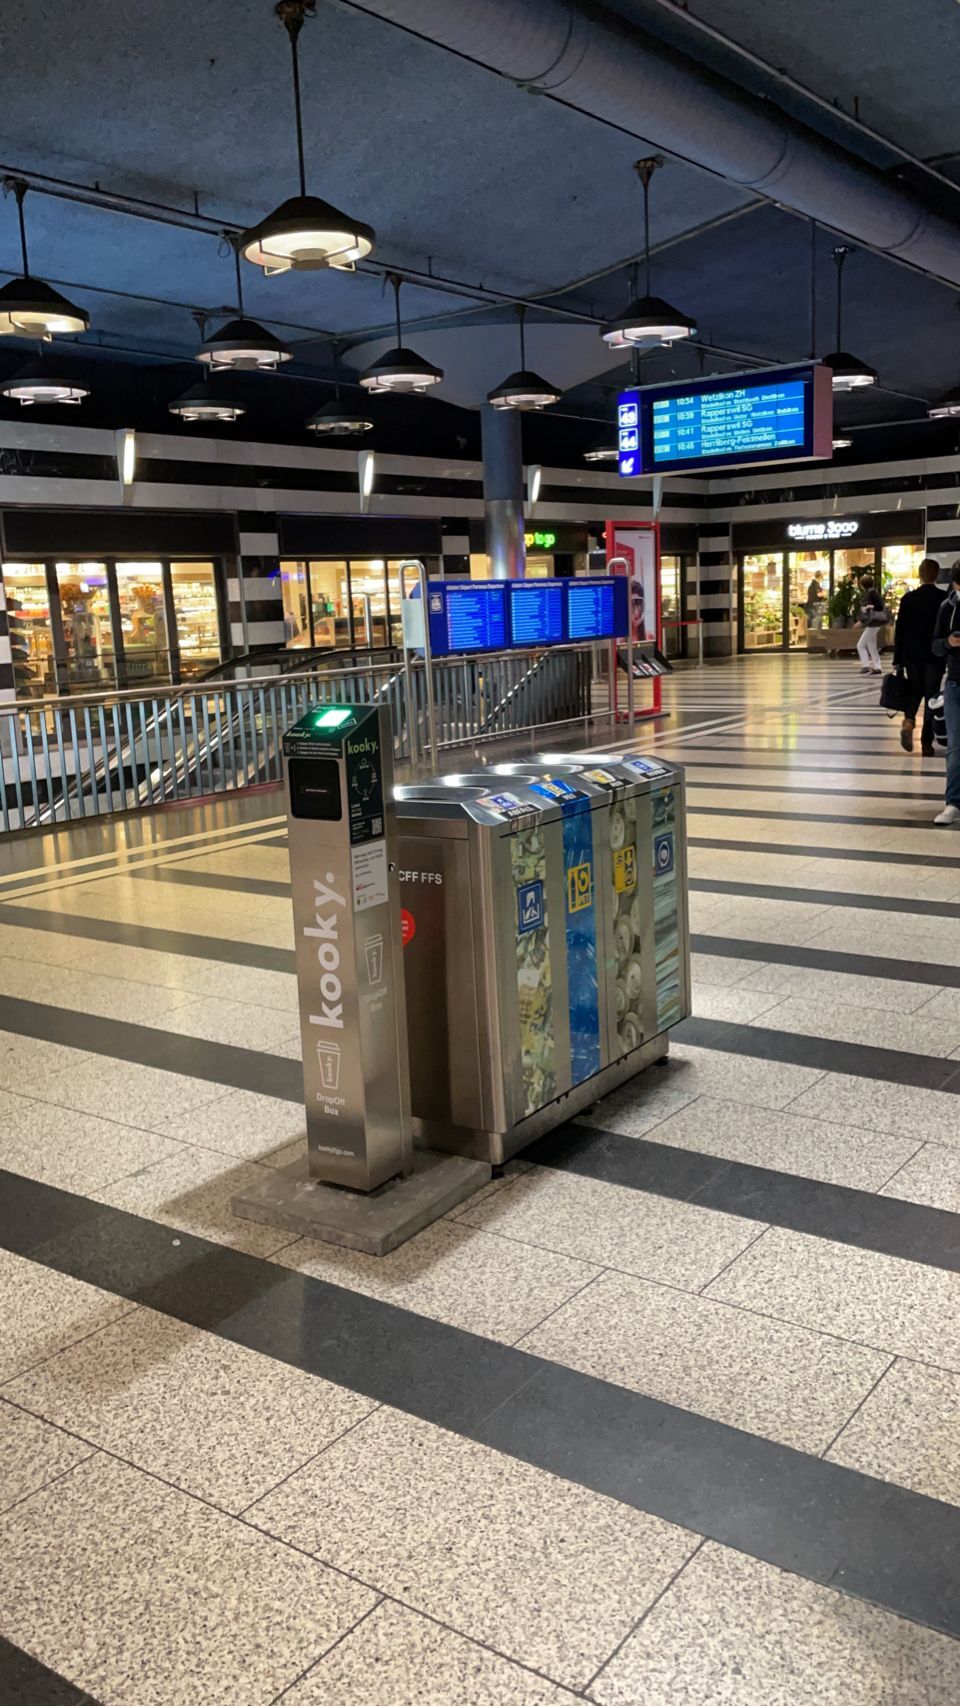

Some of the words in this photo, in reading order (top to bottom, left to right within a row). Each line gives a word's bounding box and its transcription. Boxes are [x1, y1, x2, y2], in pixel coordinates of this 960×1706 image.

[700, 392, 734, 403] Wetzikon
[734, 389, 746, 398] ZH
[701, 405, 741, 417] Rapperswil
[741, 404, 753, 413] SG
[701, 422, 741, 434] Rapperswil
[741, 420, 753, 429] SG
[347, 738, 378, 754] kooky.
[399, 870, 418, 882] CFF
[421, 872, 442, 884] FFS
[304, 872, 346, 1029] kooky.
[316, 1092, 346, 1106] DropOff
[324, 1105, 339, 1116] Box
